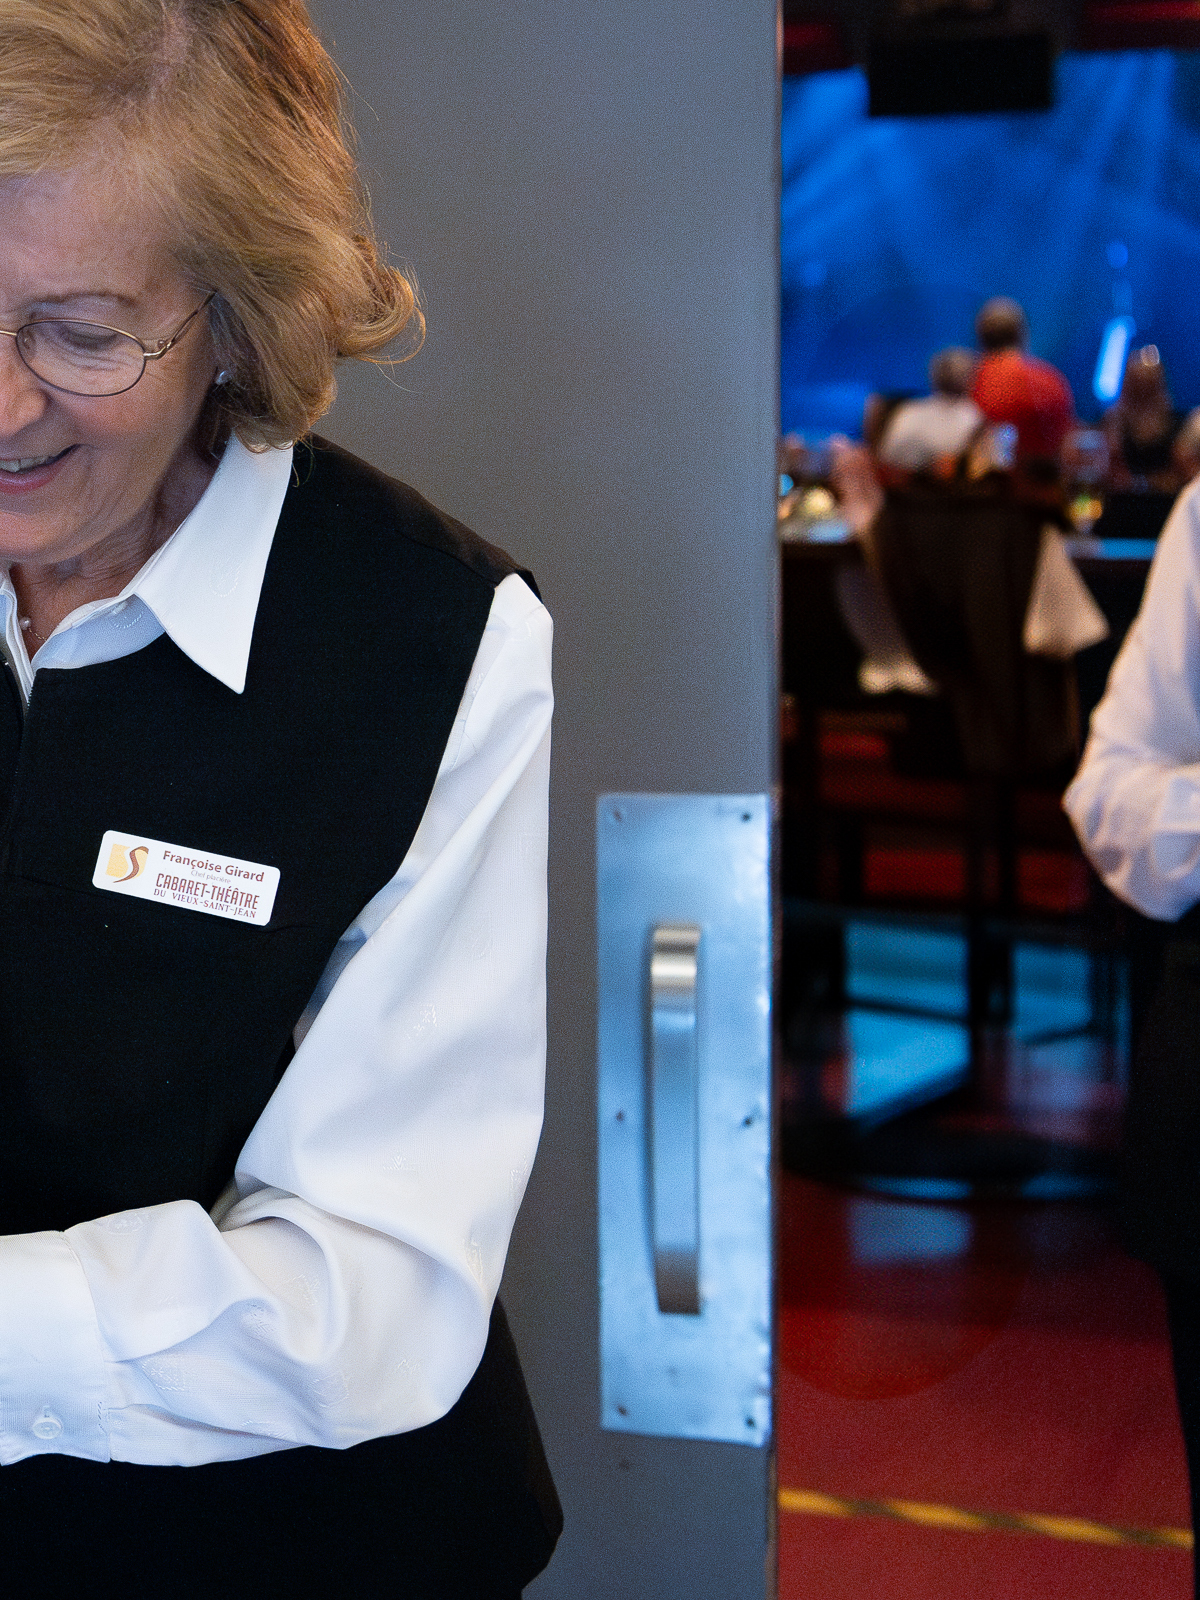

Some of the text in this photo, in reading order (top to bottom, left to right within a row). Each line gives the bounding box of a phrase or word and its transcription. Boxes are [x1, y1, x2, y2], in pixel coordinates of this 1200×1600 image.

[163, 850, 265, 882] Françoise Girard
[190, 870, 205, 878] Chef
[153, 889, 257, 918] DU VIEUX-SAINT-JEAN
[156, 873, 260, 909] CABARET-THÉÂTRE
